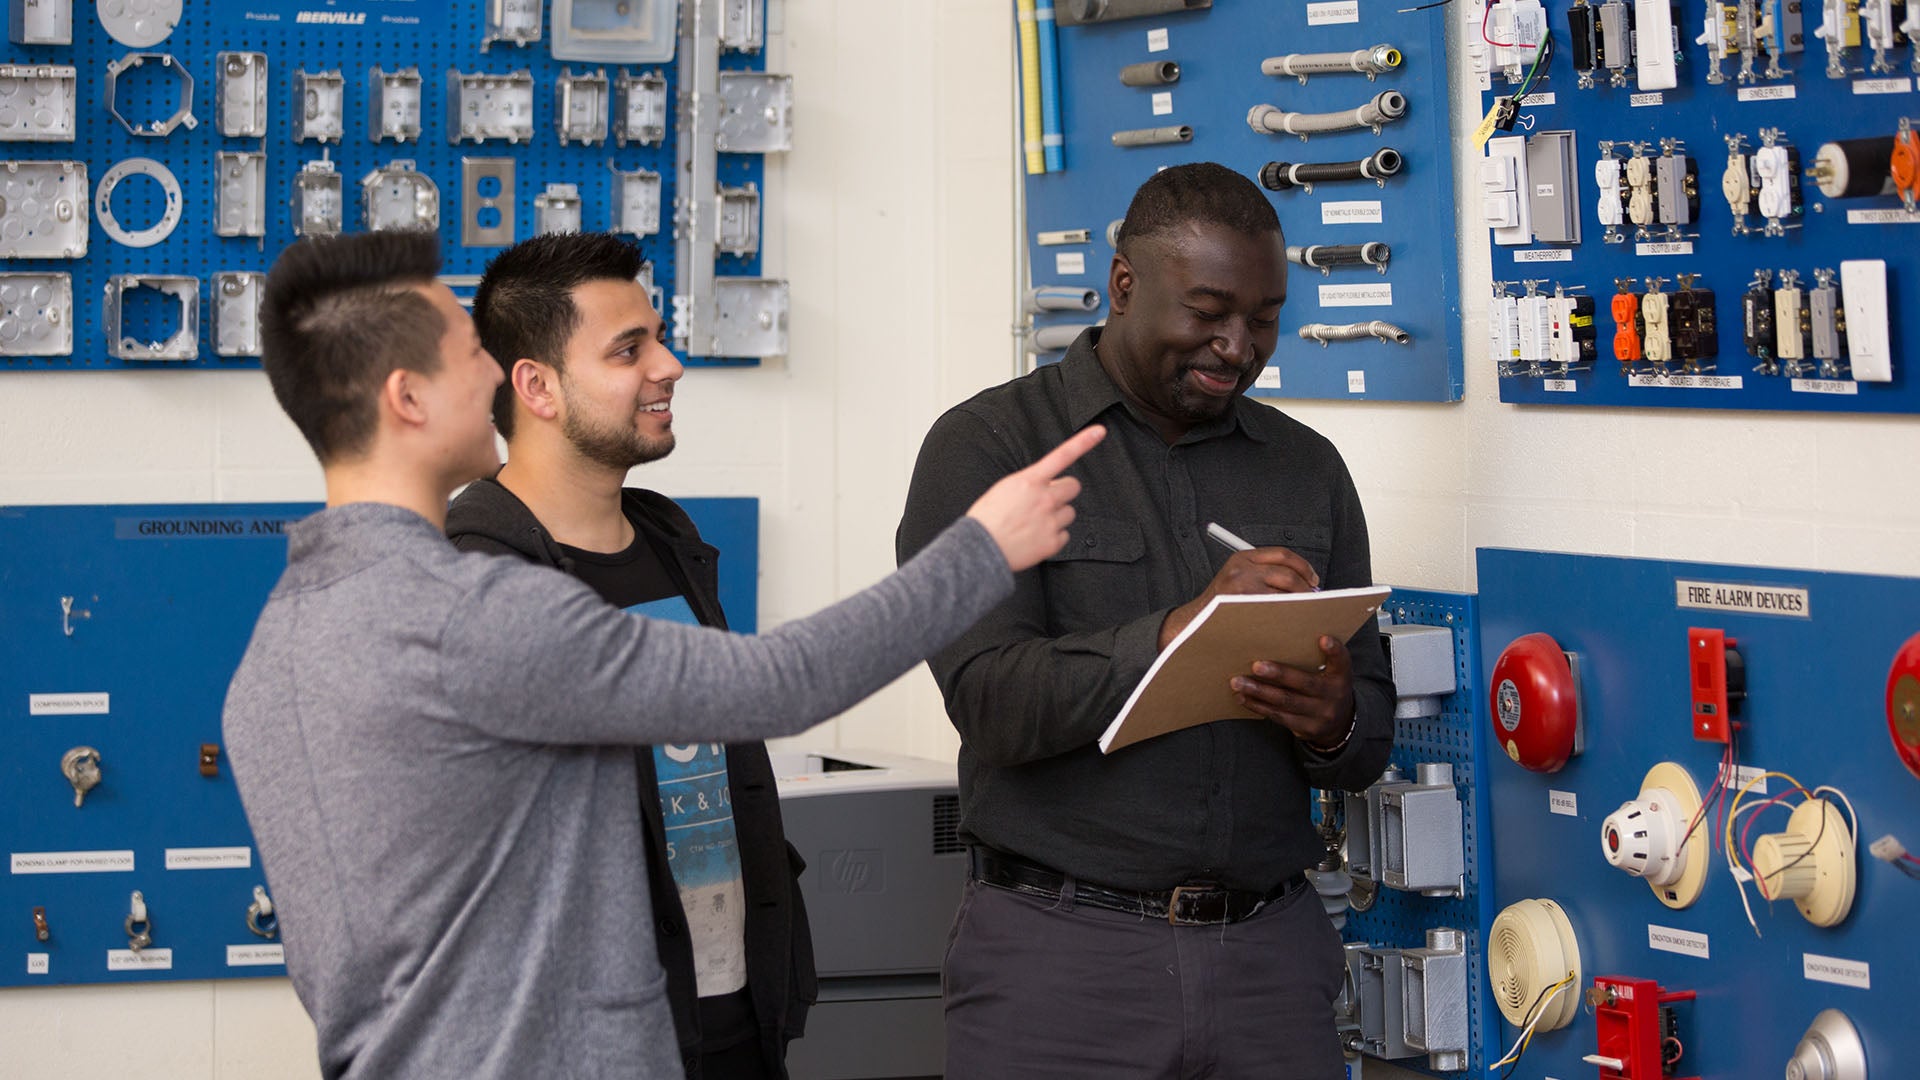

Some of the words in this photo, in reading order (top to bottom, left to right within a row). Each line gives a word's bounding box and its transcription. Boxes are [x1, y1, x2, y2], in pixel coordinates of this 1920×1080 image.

[296, 11, 366, 24] IBERVILLE
[1523, 94, 1545, 104] SENSORS
[1631, 95, 1648, 104] SINGLE
[1649, 94, 1663, 103] POLE
[1749, 89, 1768, 98] SINGLE
[1524, 251, 1562, 260] WEATHERPROOF
[138, 520, 244, 535] GROUNDING
[1688, 586, 1711, 605] FIRE
[1714, 589, 1754, 608] ALARM
[1756, 592, 1803, 611] DEVICES
[698, 792, 709, 811] &
